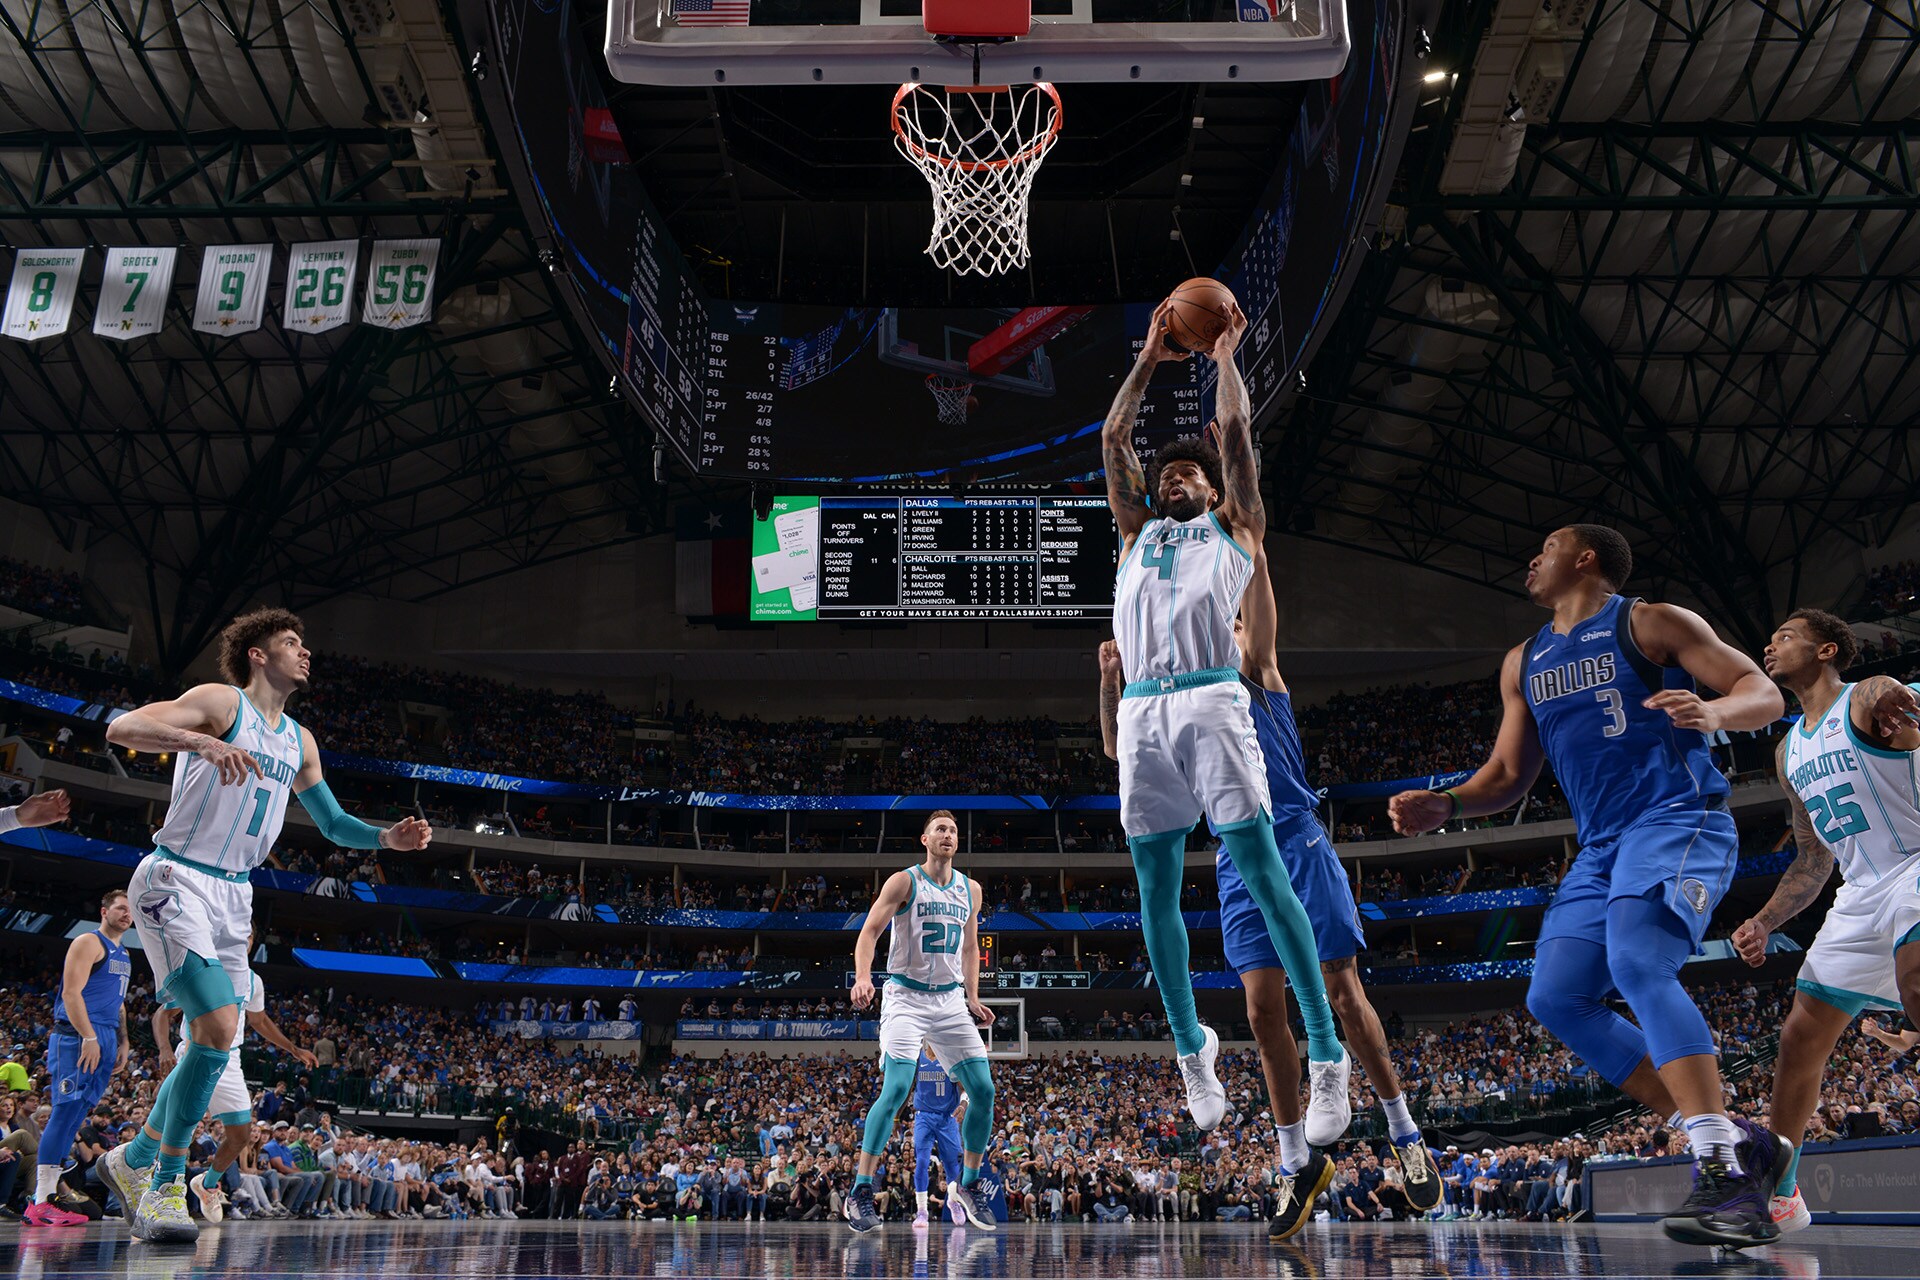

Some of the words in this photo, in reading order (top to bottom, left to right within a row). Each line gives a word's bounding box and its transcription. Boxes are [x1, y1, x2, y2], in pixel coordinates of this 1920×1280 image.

[1243, 8, 1264, 20] NBA
[219, 254, 255, 264] MODANO
[303, 251, 344, 263] LEHTINEN
[391, 250, 419, 259] ZUBOV
[22, 257, 76, 266] GOLDSWORTHY
[122, 257, 158, 266] BROTEN
[218, 271, 245, 311] 9
[294, 267, 346, 309] 26
[374, 265, 428, 305] 56
[27, 272, 57, 312] 8
[122, 272, 149, 312] 7
[640, 318, 655, 350] 45
[711, 333, 730, 342] REB
[764, 337, 776, 345] 22
[1255, 318, 1270, 352] 58
[711, 344, 723, 353] TO
[769, 349, 776, 357] 5
[709, 358, 727, 367] BLK
[1190, 363, 1196, 371] 2
[708, 369, 724, 379] STL
[770, 374, 775, 382] 1
[678, 370, 692, 401] 58
[653, 376, 673, 409] 2:13
[707, 388, 719, 397] FG
[745, 391, 773, 401] 26/42
[1173, 389, 1198, 398] 14/41
[706, 401, 727, 410] 3-PT
[757, 404, 773, 414] 2/7
[1178, 403, 1199, 411] 5/21
[705, 414, 716, 423] FT
[756, 418, 771, 427] 4/8
[1135, 419, 1146, 427] FT
[1173, 416, 1199, 425] 12/16
[704, 431, 716, 441] FG
[750, 435, 771, 445] 61%
[1135, 437, 1148, 445] FG
[703, 445, 724, 454] 3-PT
[1136, 449, 1156, 458] 3-PT
[702, 458, 714, 467] FT
[905, 499, 939, 507] DALLAS
[789, 549, 809, 558] chime
[905, 555, 957, 563] CHARLOTTE
[1141, 544, 1176, 580] 4
[1581, 629, 1612, 643] chime
[1529, 652, 1616, 706] DALLAS
[1595, 688, 1627, 738] 3
[245, 787, 271, 837] 1
[1804, 782, 1872, 844] 25
[917, 901, 968, 922] CHARLOTTE
[922, 922, 962, 955] 20
[982, 936, 993, 948] 13
[552, 1027, 577, 1036] EVO
[820, 1022, 849, 1037] Crew
[919, 1071, 946, 1081] DALLAS
[935, 1082, 945, 1096] 11
[1840, 1174, 1855, 1187] For
[1857, 1174, 1873, 1187] The
[1874, 1172, 1917, 1187] Workout
